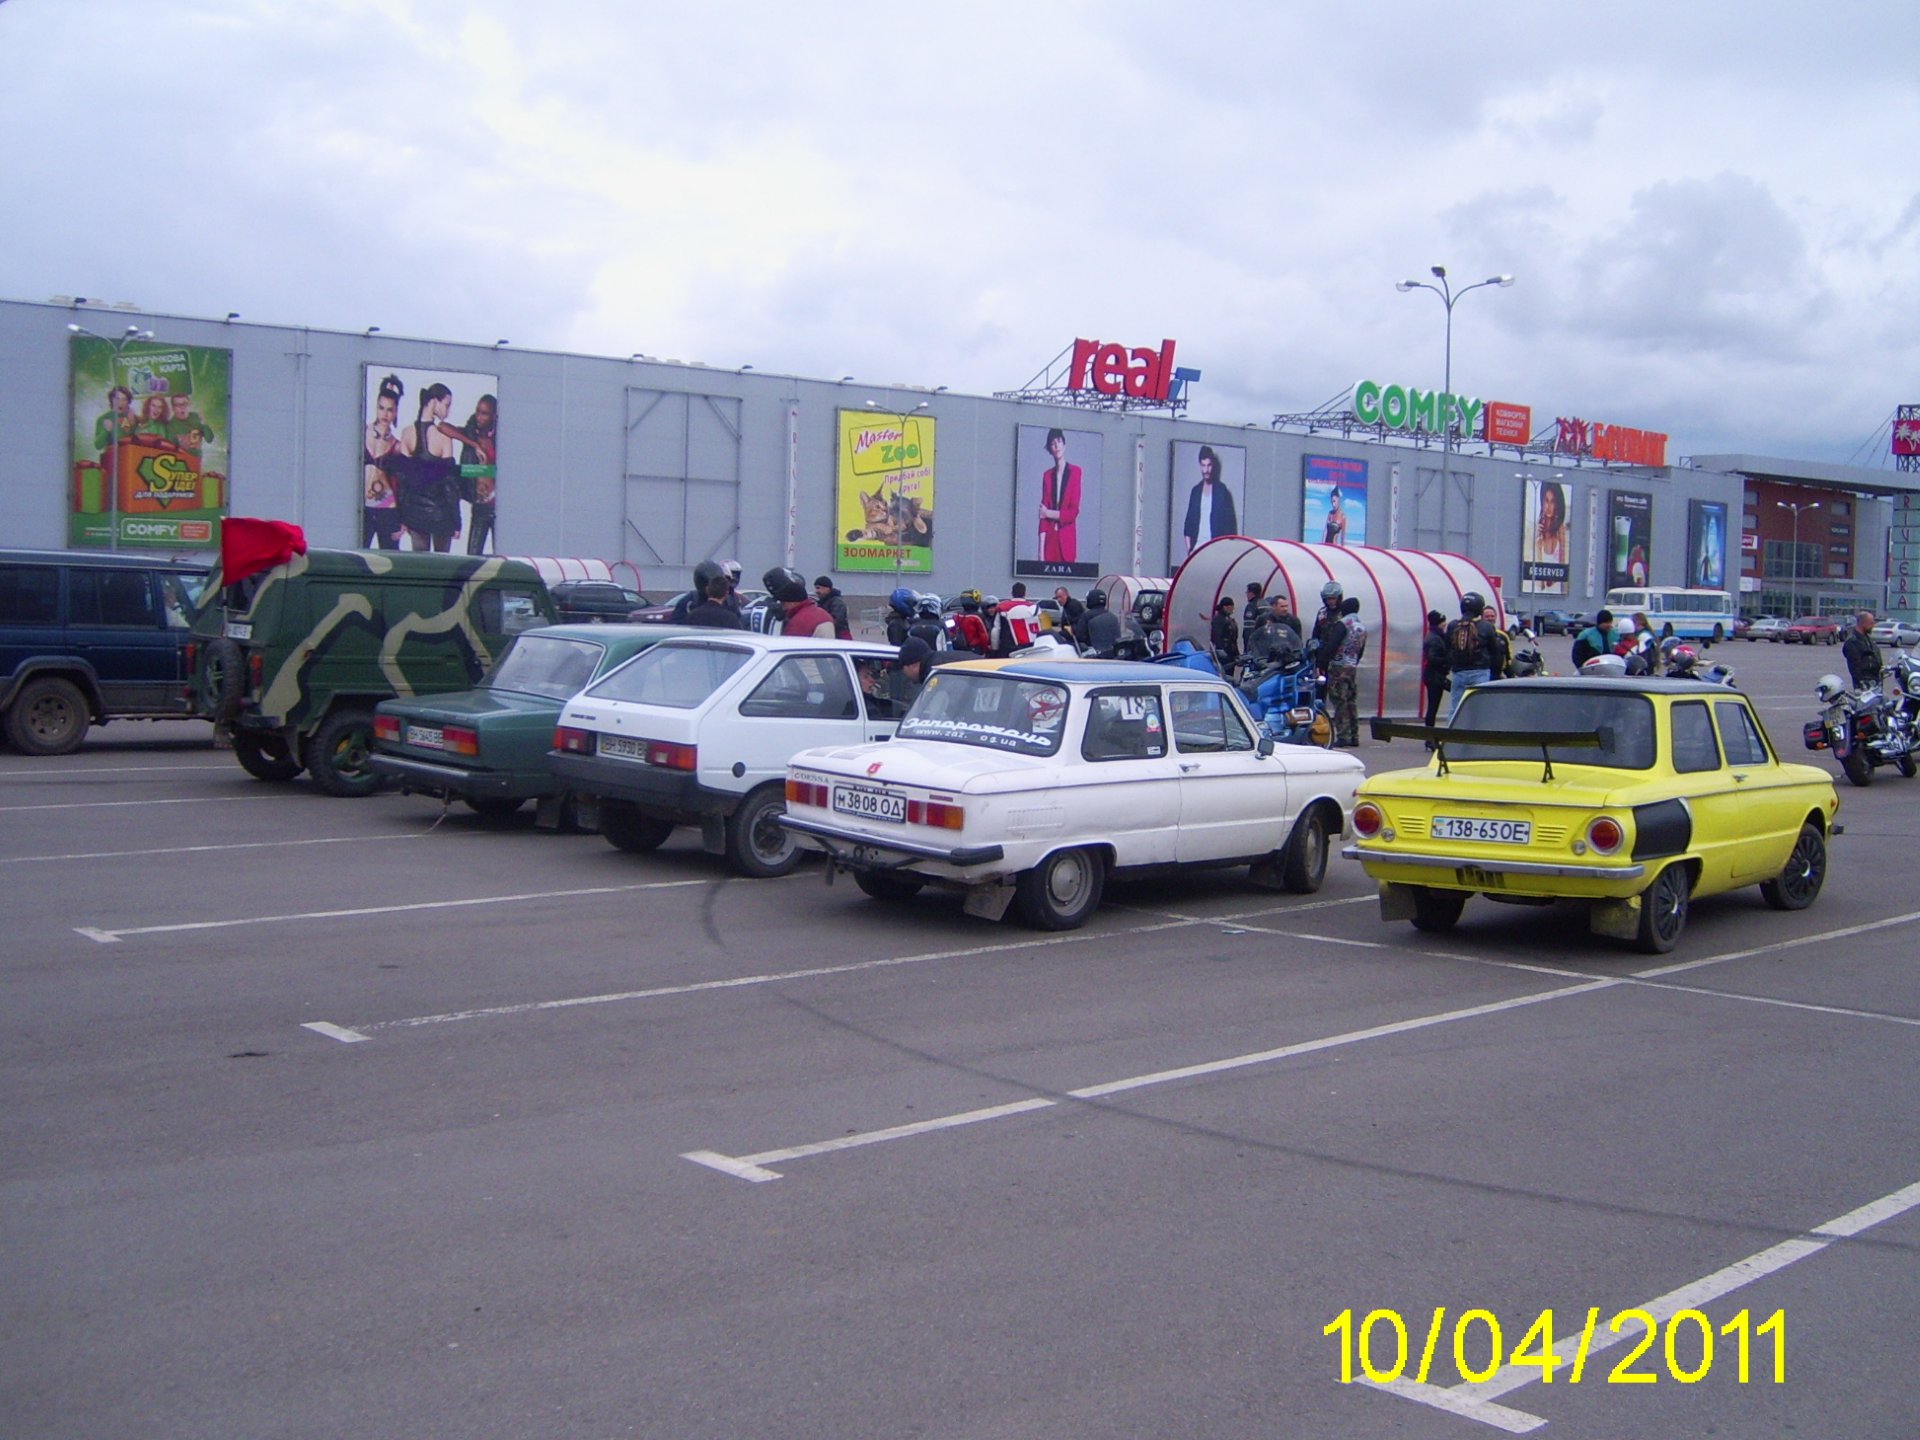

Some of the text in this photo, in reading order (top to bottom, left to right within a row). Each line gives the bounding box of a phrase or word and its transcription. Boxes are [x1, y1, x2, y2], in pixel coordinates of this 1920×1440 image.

[1067, 337, 1176, 401] real
[1354, 379, 1481, 439] COMFY
[854, 429, 903, 454] Master
[126, 523, 178, 536] COMFY
[843, 547, 912, 558] ЗООМАРКЕТ
[1898, 495, 1911, 609] RIVIERA
[1043, 564, 1072, 574] ZARA
[1529, 566, 1565, 578] RESERVED
